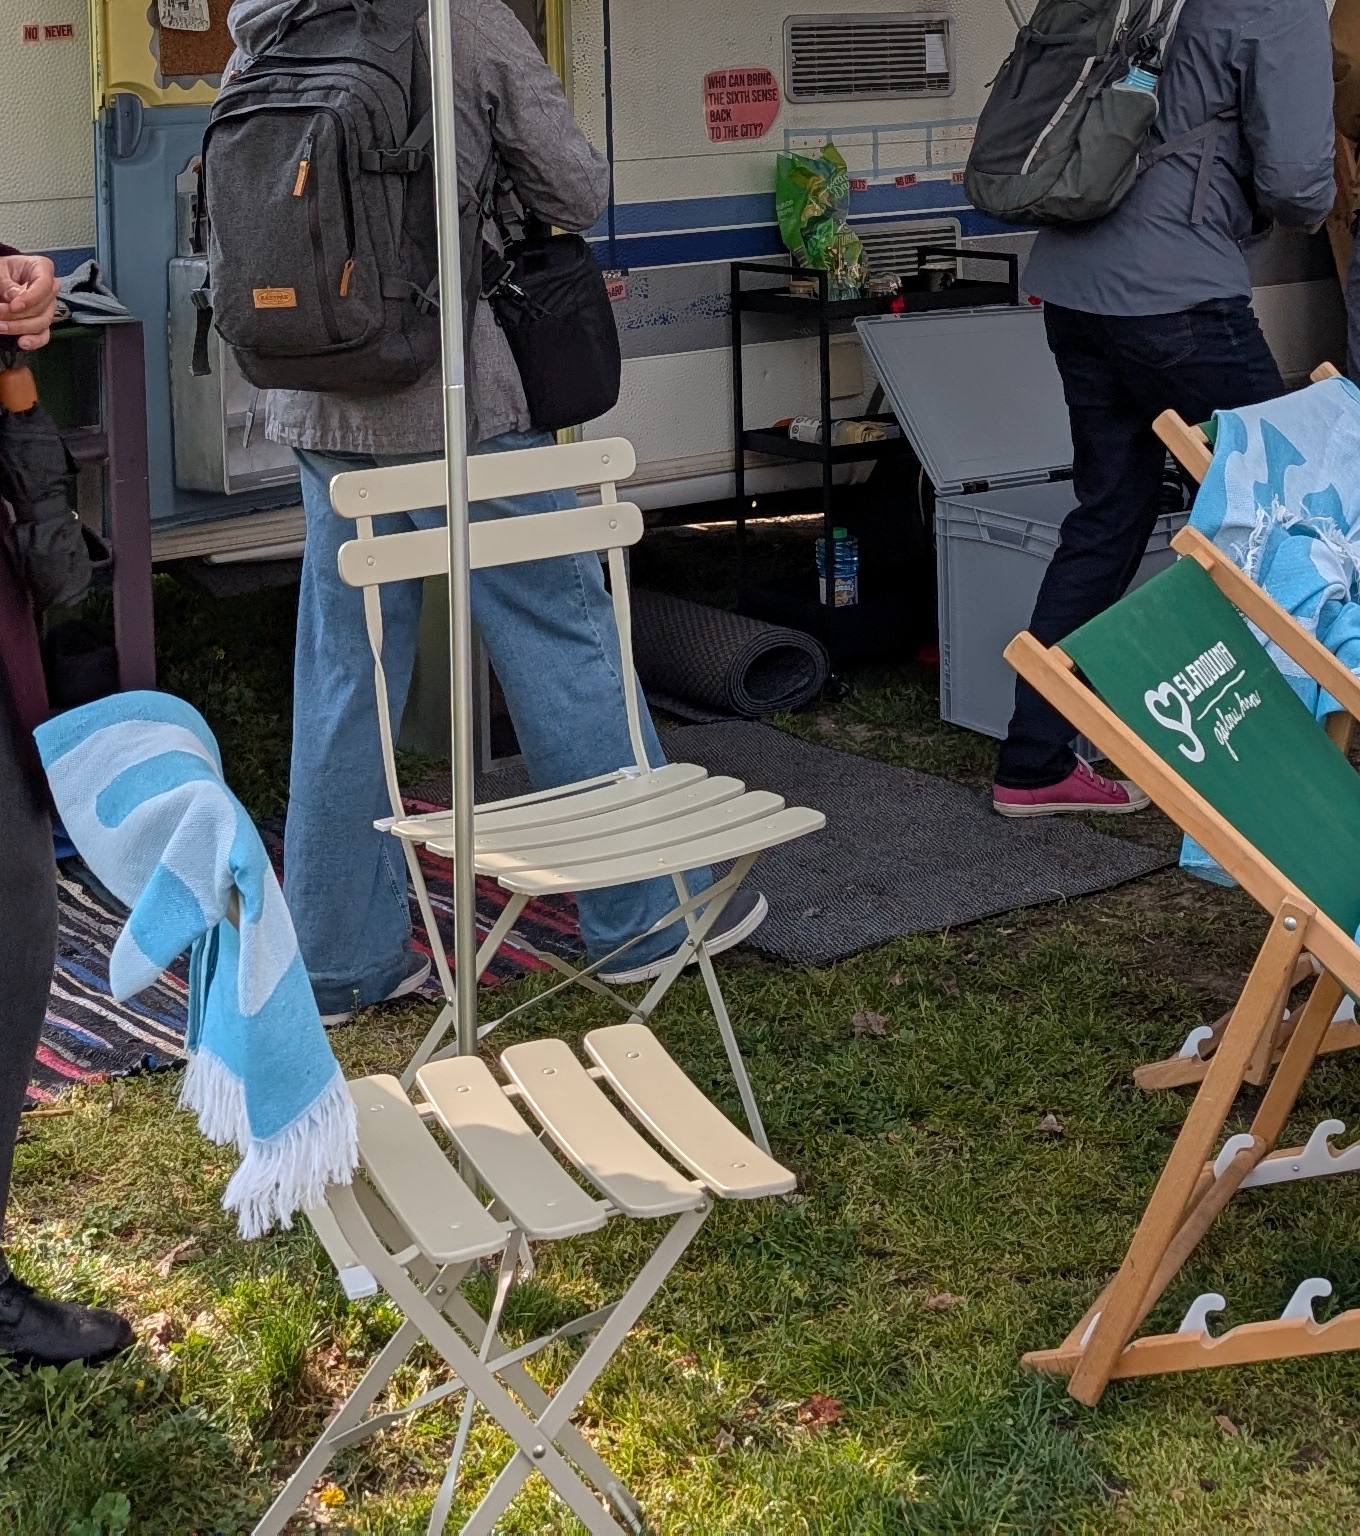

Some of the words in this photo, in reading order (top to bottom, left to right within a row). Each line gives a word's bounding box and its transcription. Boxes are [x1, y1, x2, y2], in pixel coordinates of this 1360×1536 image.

[24, 26, 38, 40] NO
[44, 24, 73, 38] NEVER
[707, 75, 727, 90] WHO
[728, 73, 746, 88] CAN
[746, 71, 772, 87] BRING
[708, 91, 725, 106] THE
[726, 89, 751, 105] SIXTH
[751, 87, 778, 103] SENSE
[709, 108, 733, 123] BACK
[710, 125, 722, 140] TO
[722, 124, 739, 139] THE
[740, 122, 764, 137] CITY?
